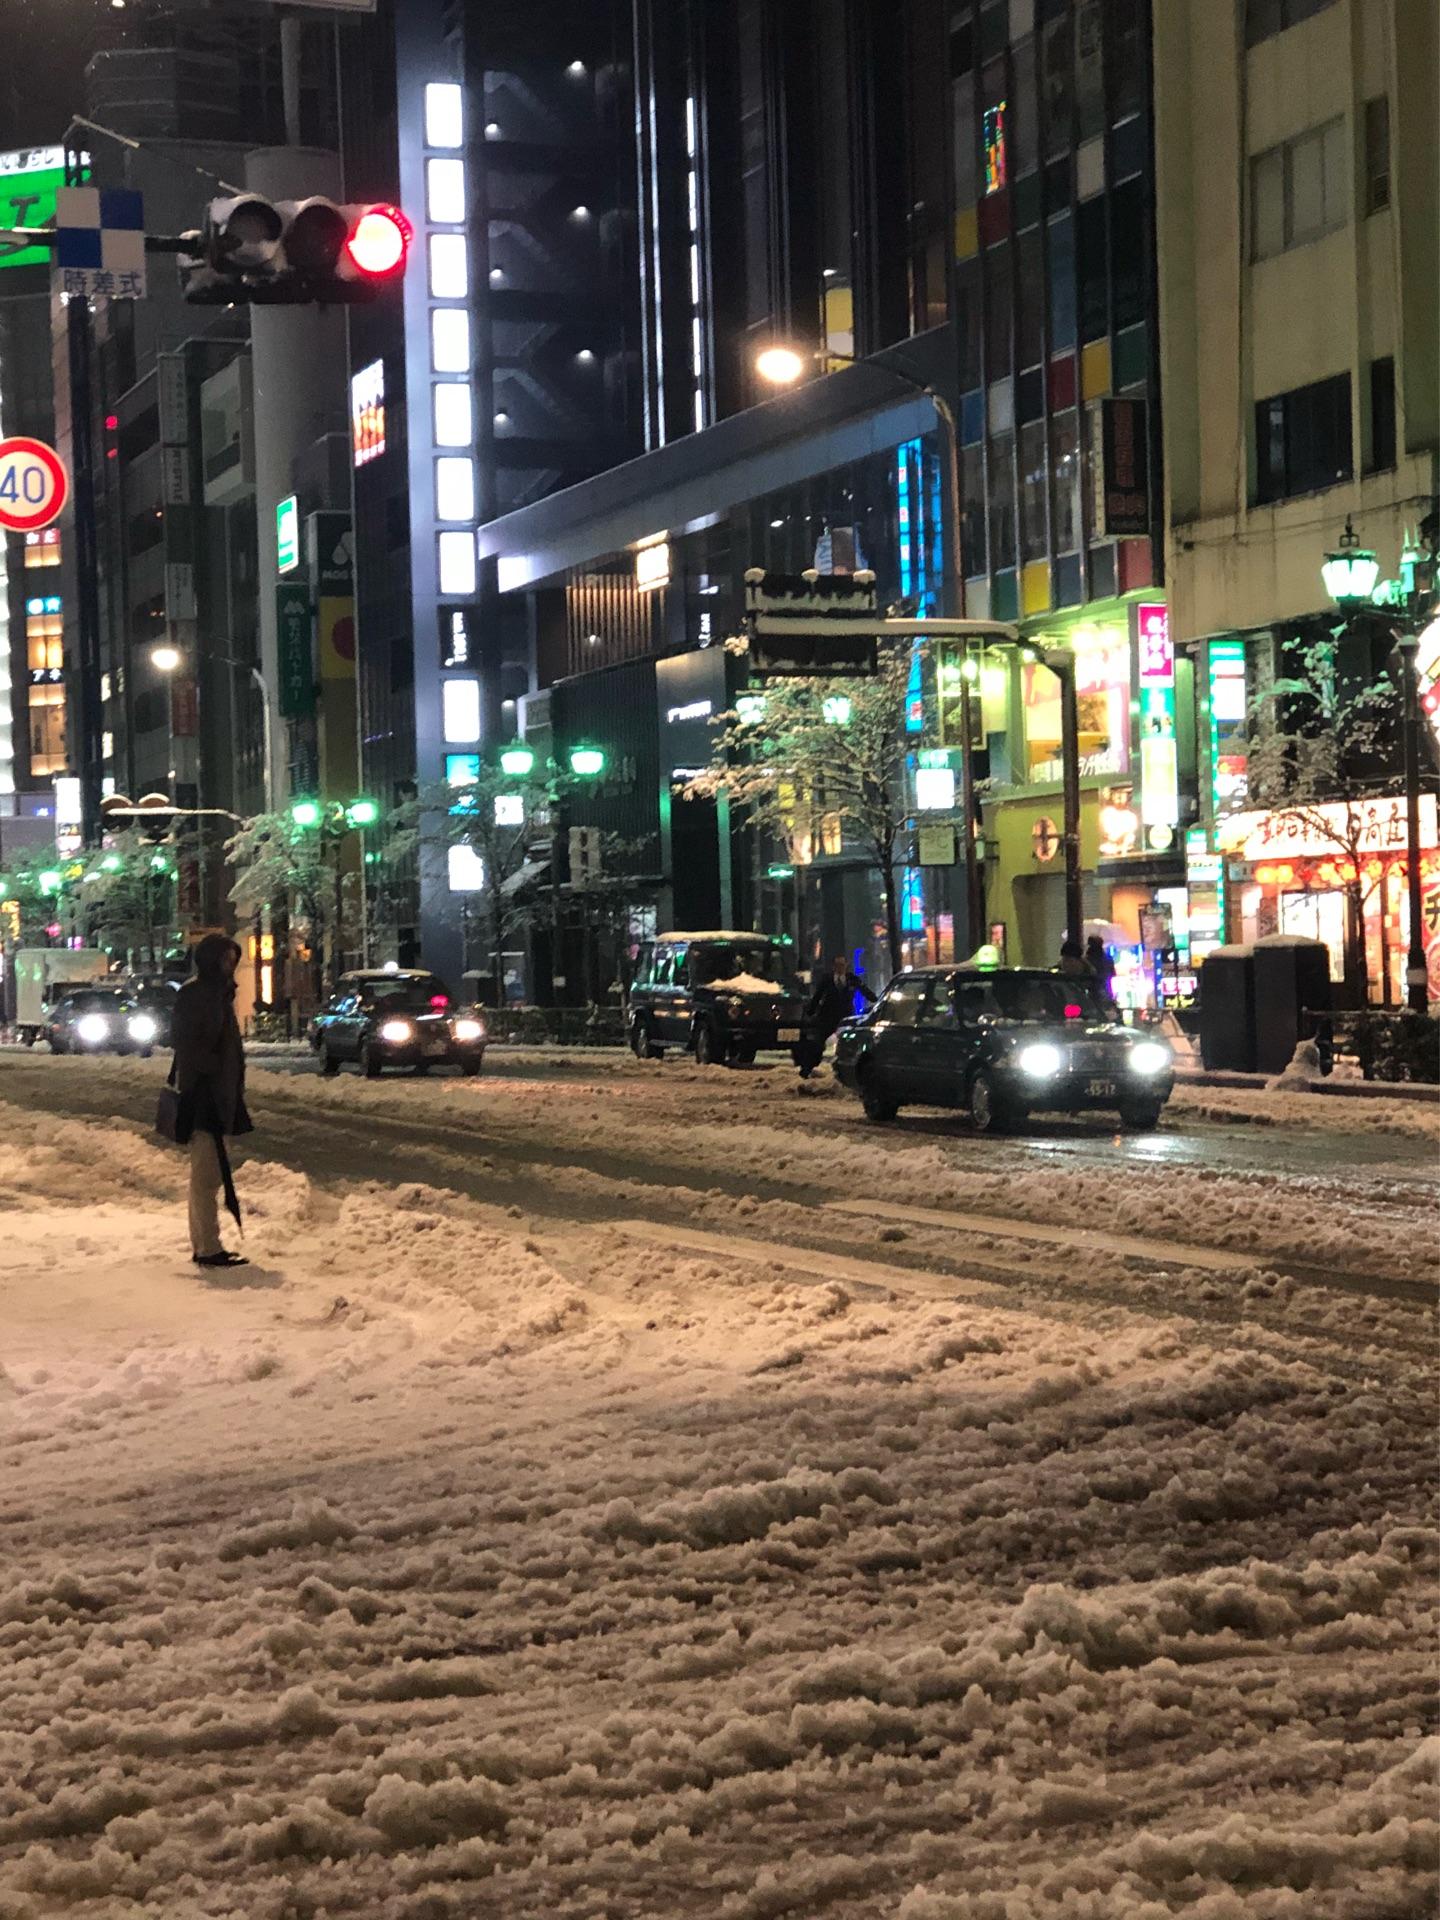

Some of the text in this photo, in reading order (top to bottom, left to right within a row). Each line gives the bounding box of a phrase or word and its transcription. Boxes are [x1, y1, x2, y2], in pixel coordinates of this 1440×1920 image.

[63, 269, 142, 296] 時差式
[0, 465, 46, 503] 40
